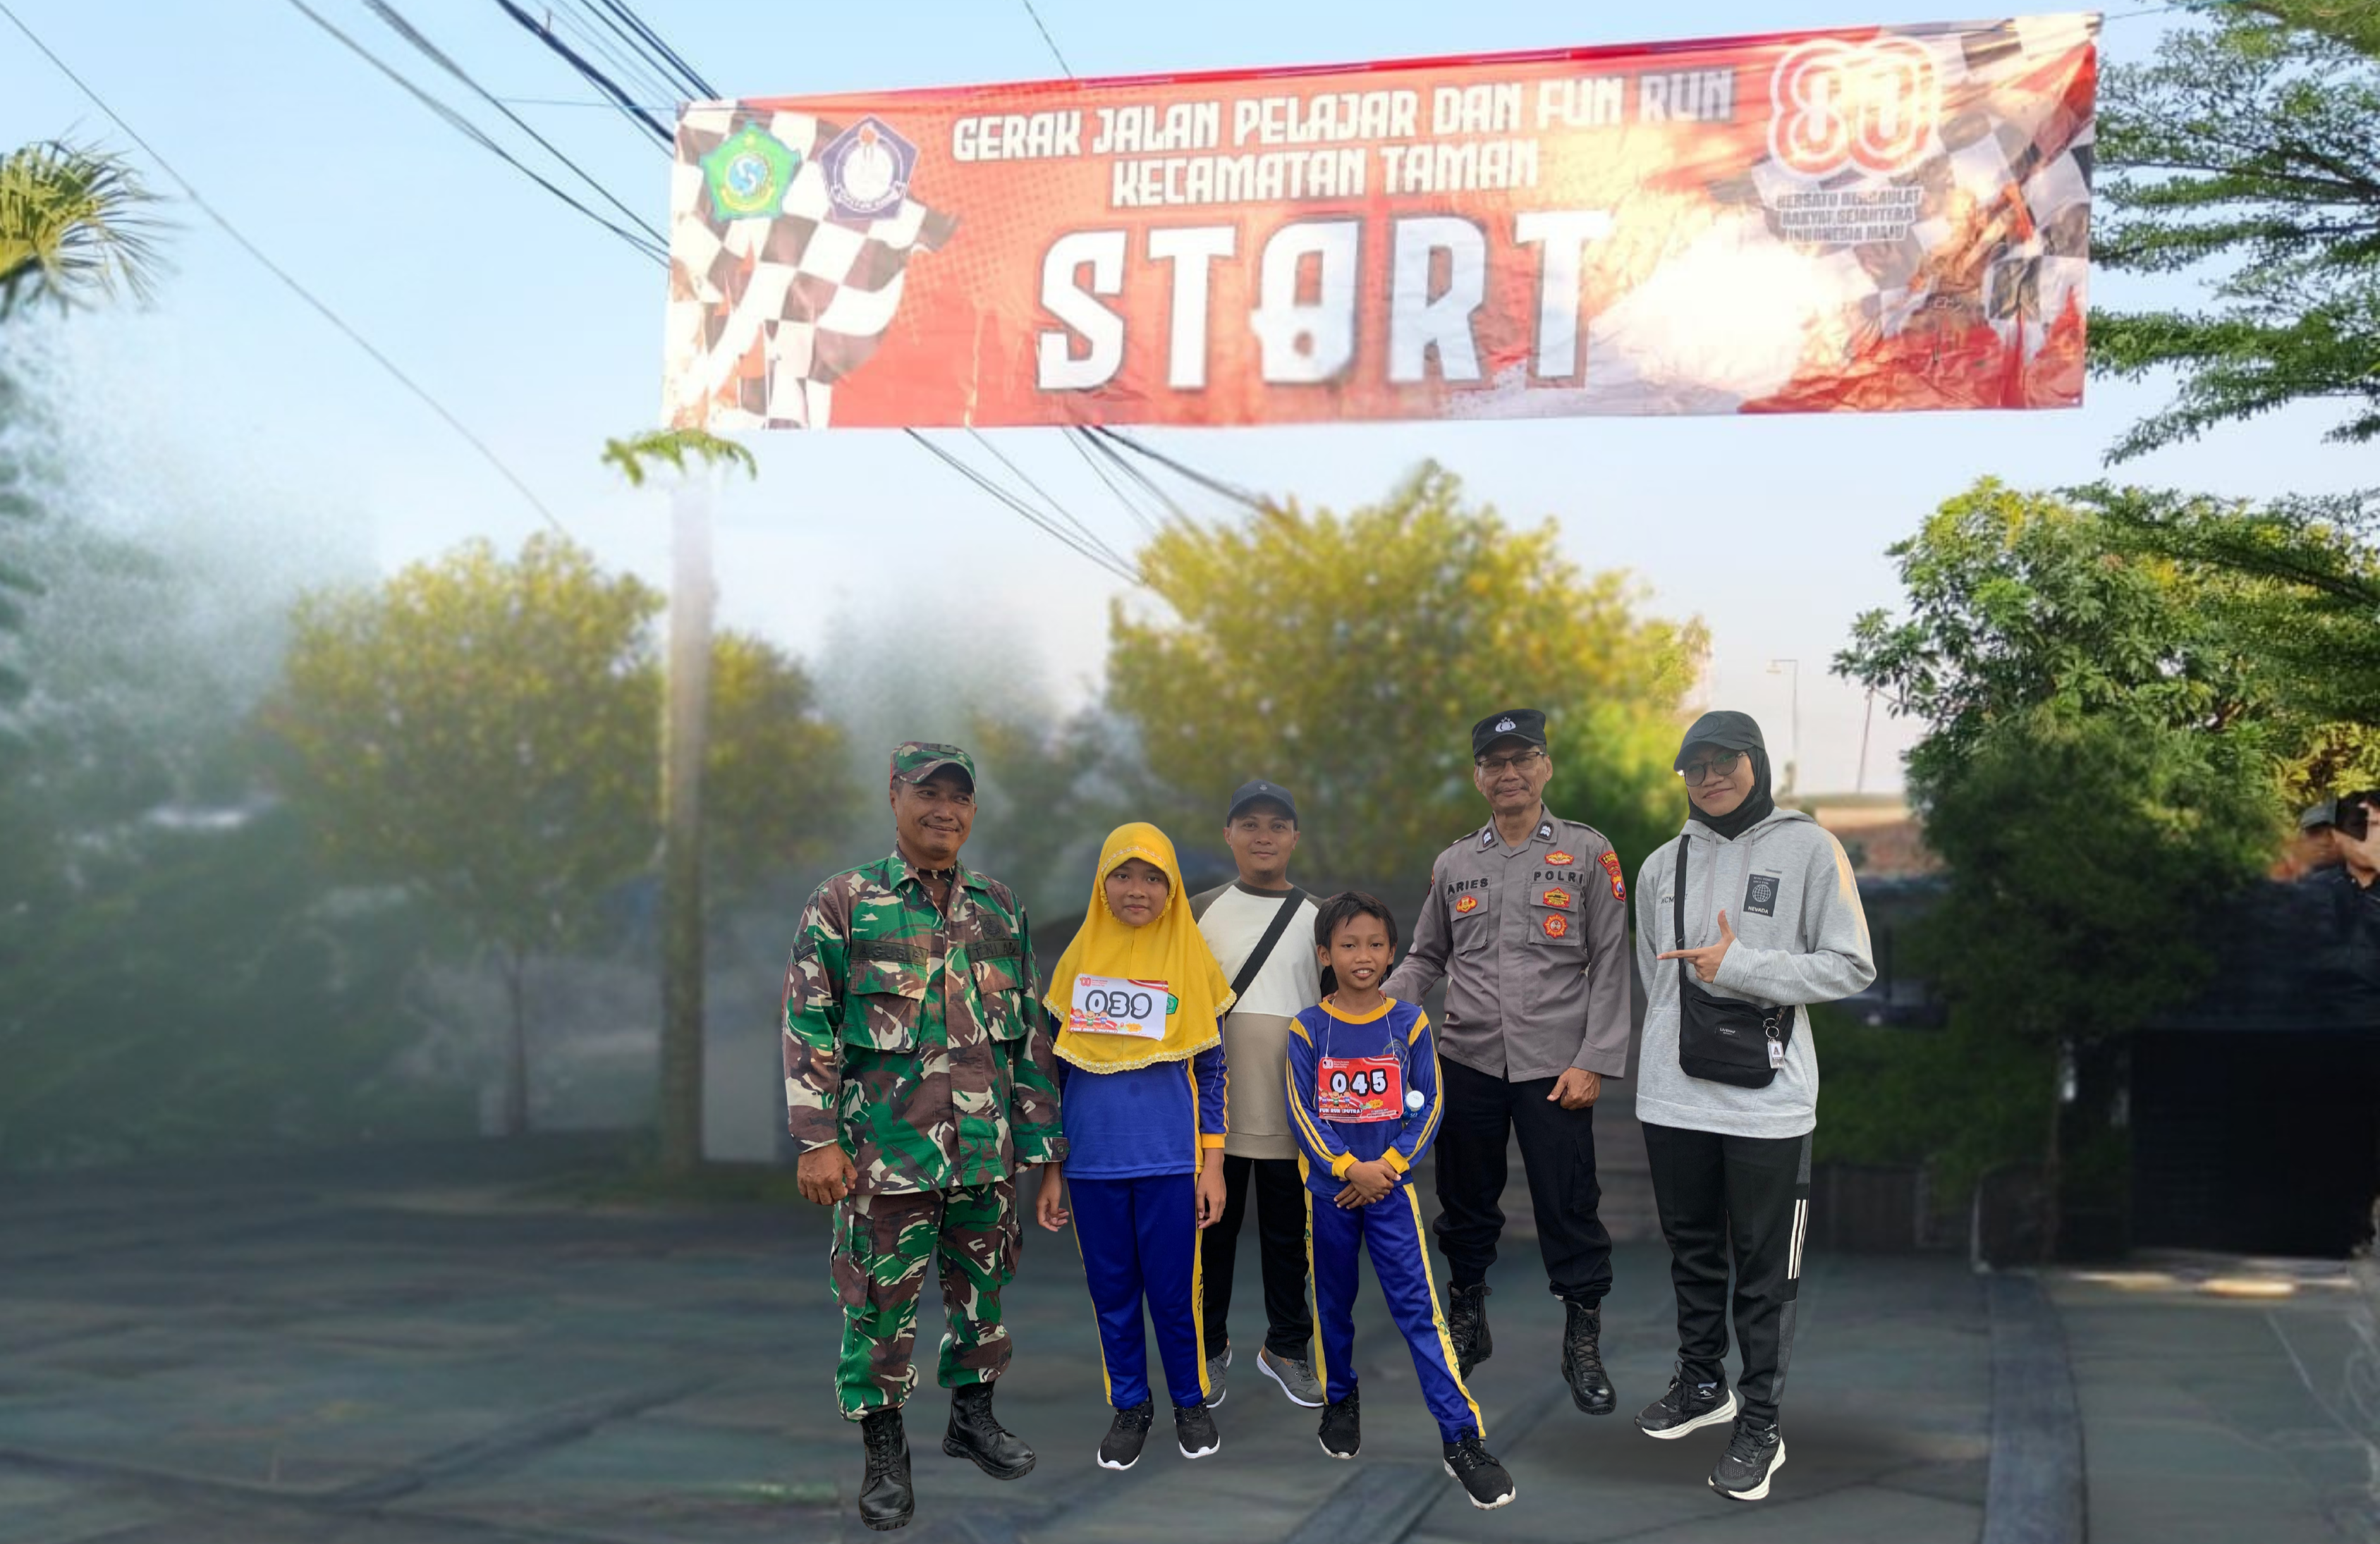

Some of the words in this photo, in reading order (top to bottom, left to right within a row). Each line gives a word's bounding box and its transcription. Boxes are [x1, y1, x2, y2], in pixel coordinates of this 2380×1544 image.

[952, 110, 1081, 162] GERAK
[1092, 101, 1220, 154] JALAN
[1234, 89, 1417, 147] PELAJAR
[1433, 82, 1522, 135] DAN
[1537, 77, 1624, 129] FUN
[1640, 70, 1735, 122] RUN
[1113, 149, 1365, 207] KECAMATAN
[1380, 139, 1538, 195] TAMAN
[1037, 211, 1615, 389] START
[1447, 877, 1489, 895] ARIES
[1533, 870, 1584, 884] POLRI
[1747, 905, 1769, 914] NEVADA
[972, 943, 998, 957] TNI
[1003, 941, 1017, 954] AD
[1085, 989, 1152, 1020] 039
[1330, 1067, 1389, 1097] 045
